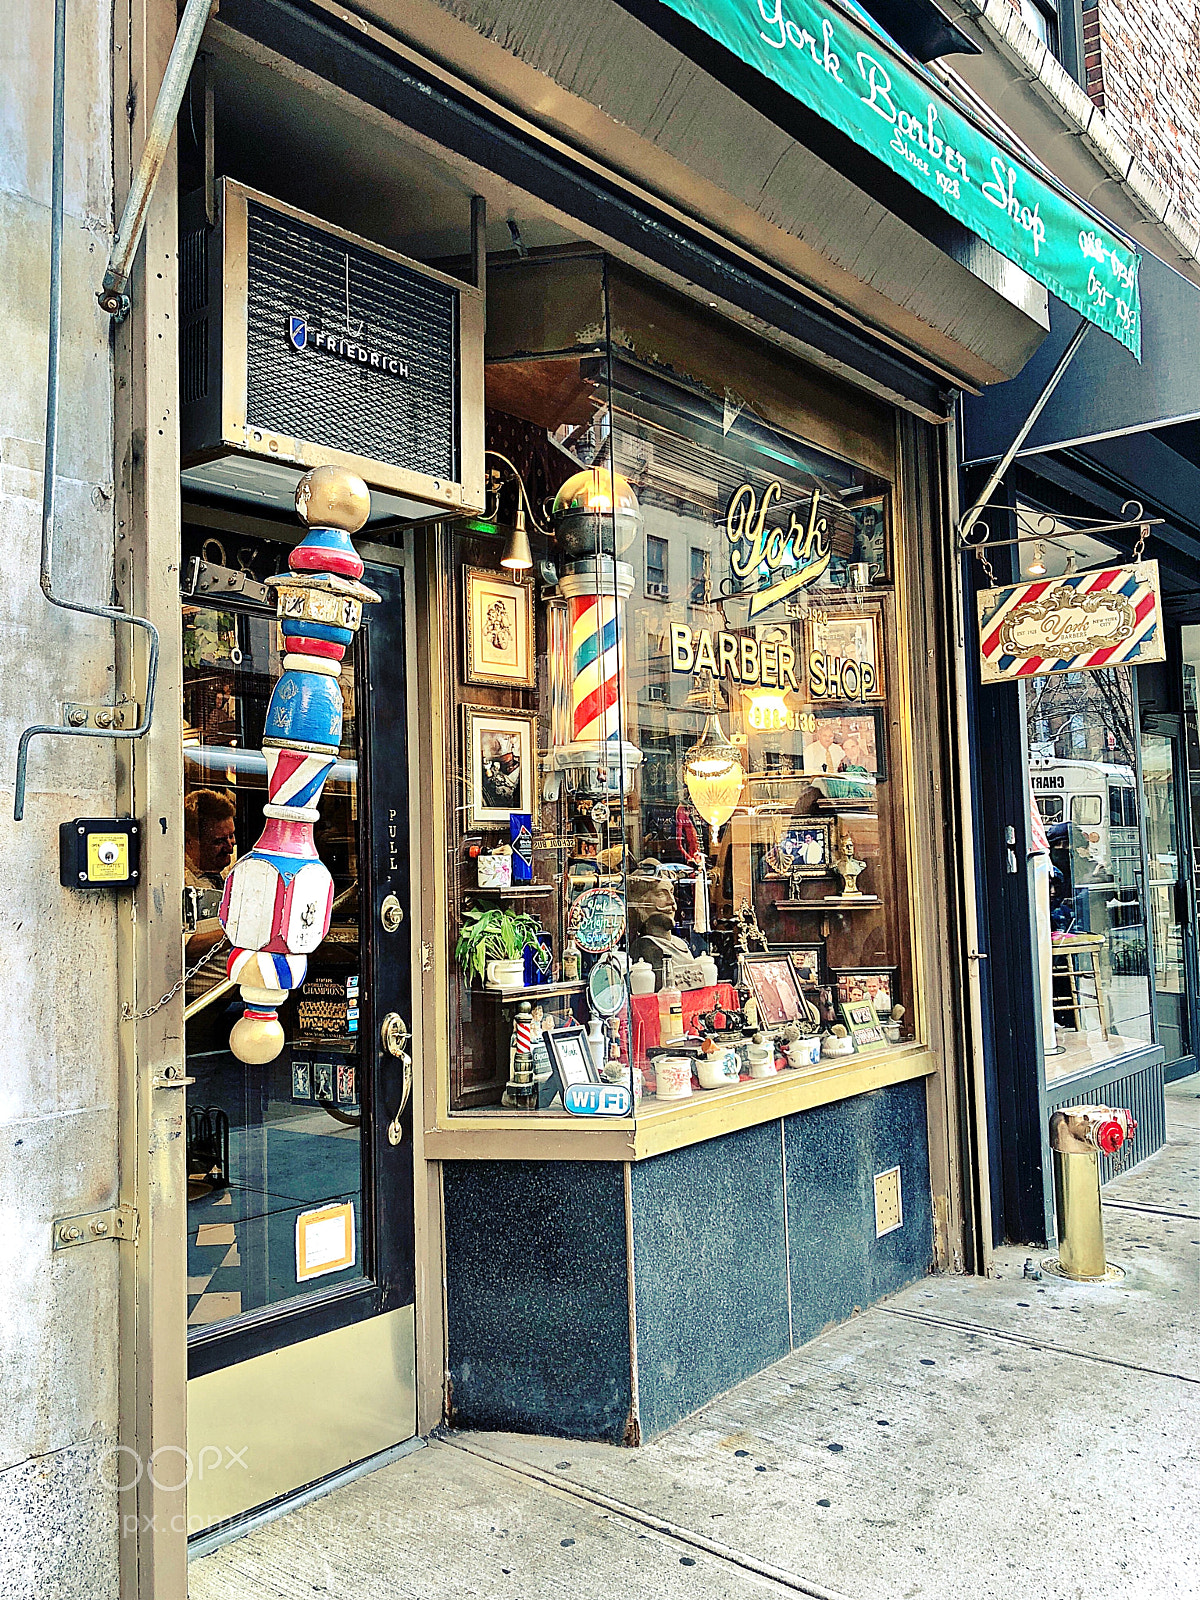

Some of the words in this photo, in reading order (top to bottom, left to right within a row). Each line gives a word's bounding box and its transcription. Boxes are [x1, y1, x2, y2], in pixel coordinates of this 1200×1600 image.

[759, 0, 843, 83] York
[856, 52, 970, 182] Barber
[981, 157, 1046, 257] Shop
[889, 127, 931, 176] Since
[935, 170, 960, 199] 1928
[316, 333, 409, 378] FRIEDRICH
[724, 481, 831, 580] York
[807, 606, 828, 626] 1928
[1040, 614, 1090, 642] York
[1060, 631, 1087, 641] BARBERS
[669, 621, 800, 693] BARBER
[809, 649, 876, 704] SHOP
[388, 808, 398, 870] PULL
[302, 984, 345, 996] CHAMPIONS
